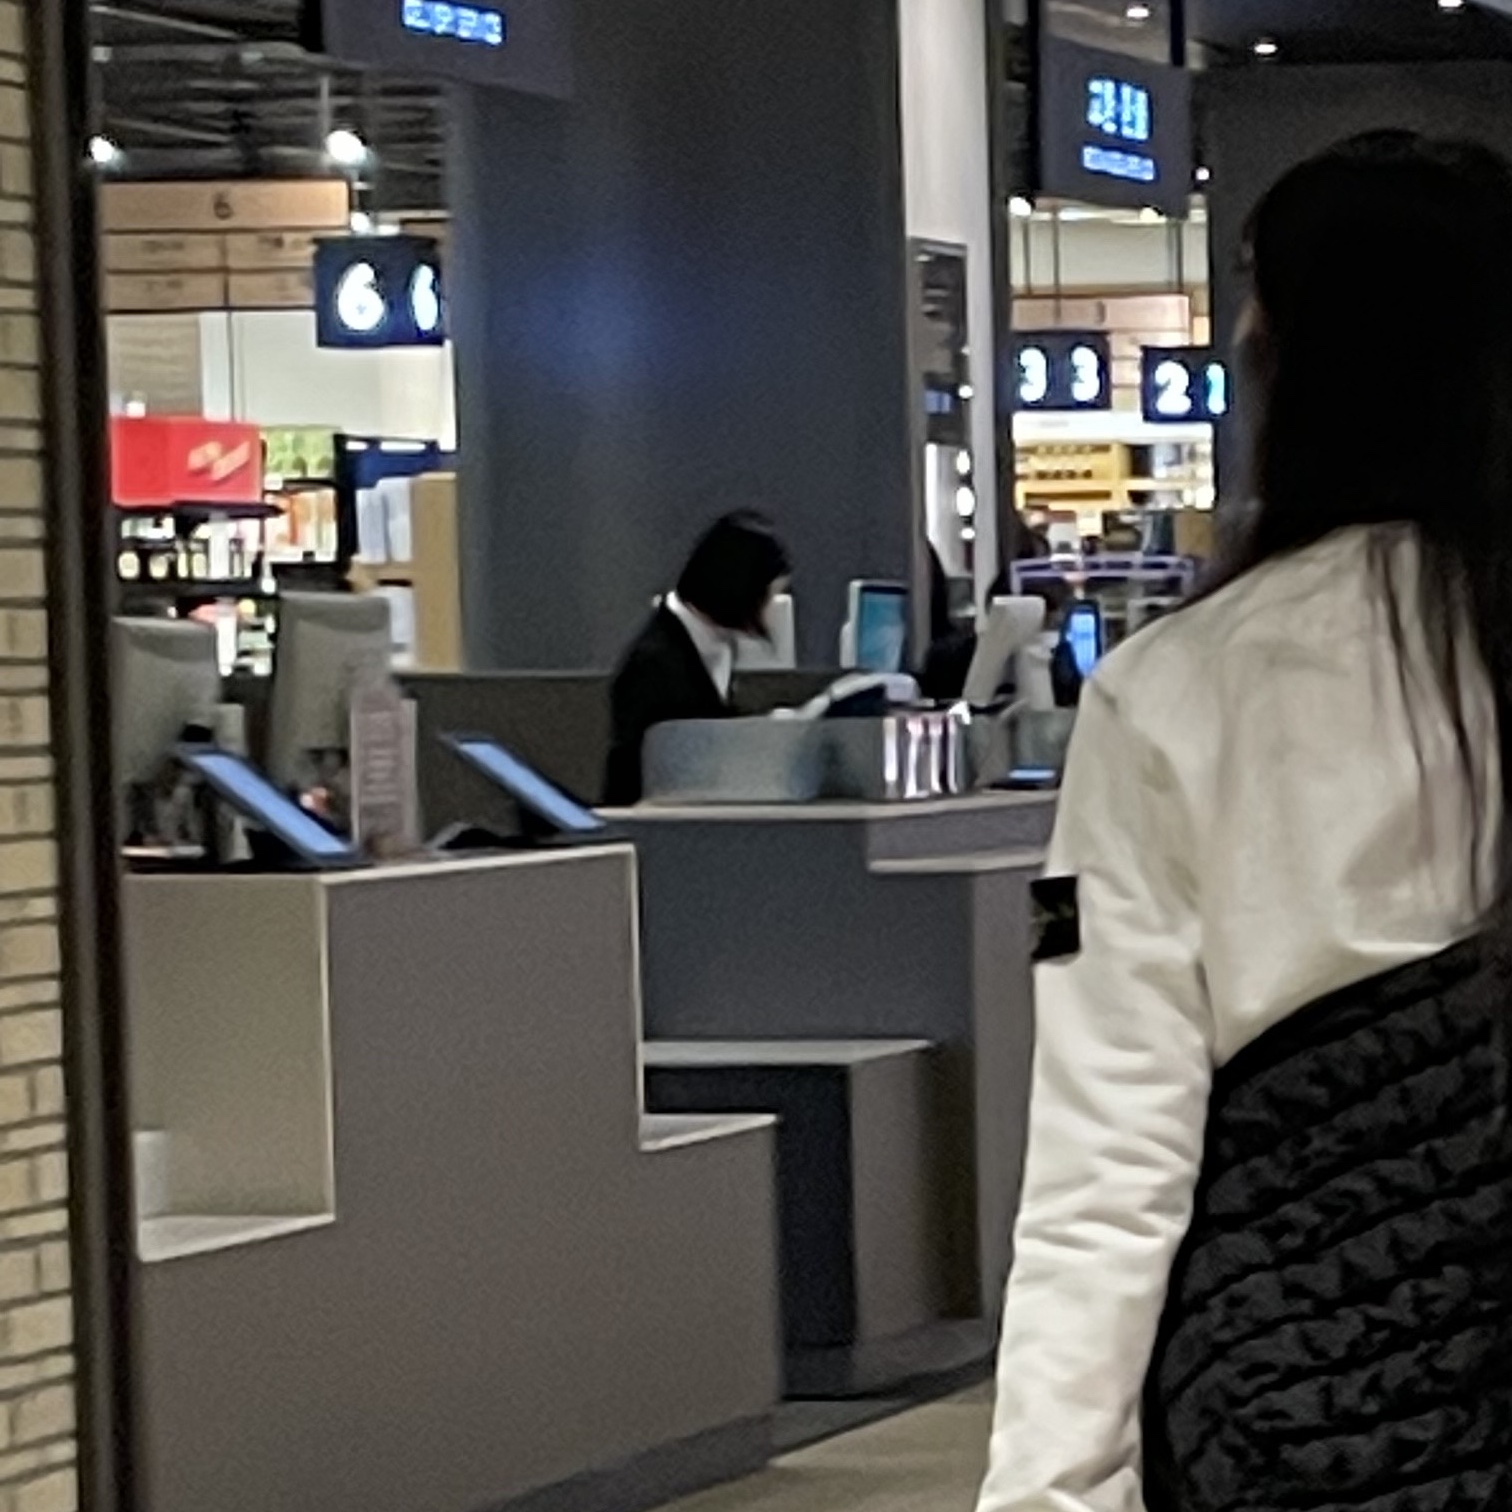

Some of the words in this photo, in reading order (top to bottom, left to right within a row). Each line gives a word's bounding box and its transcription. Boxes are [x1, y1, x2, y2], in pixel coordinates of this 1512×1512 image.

[337, 263, 386, 331] 6
[1019, 347, 1047, 402] 3
[1071, 346, 1100, 402] 3
[1154, 361, 1192, 415] 2
